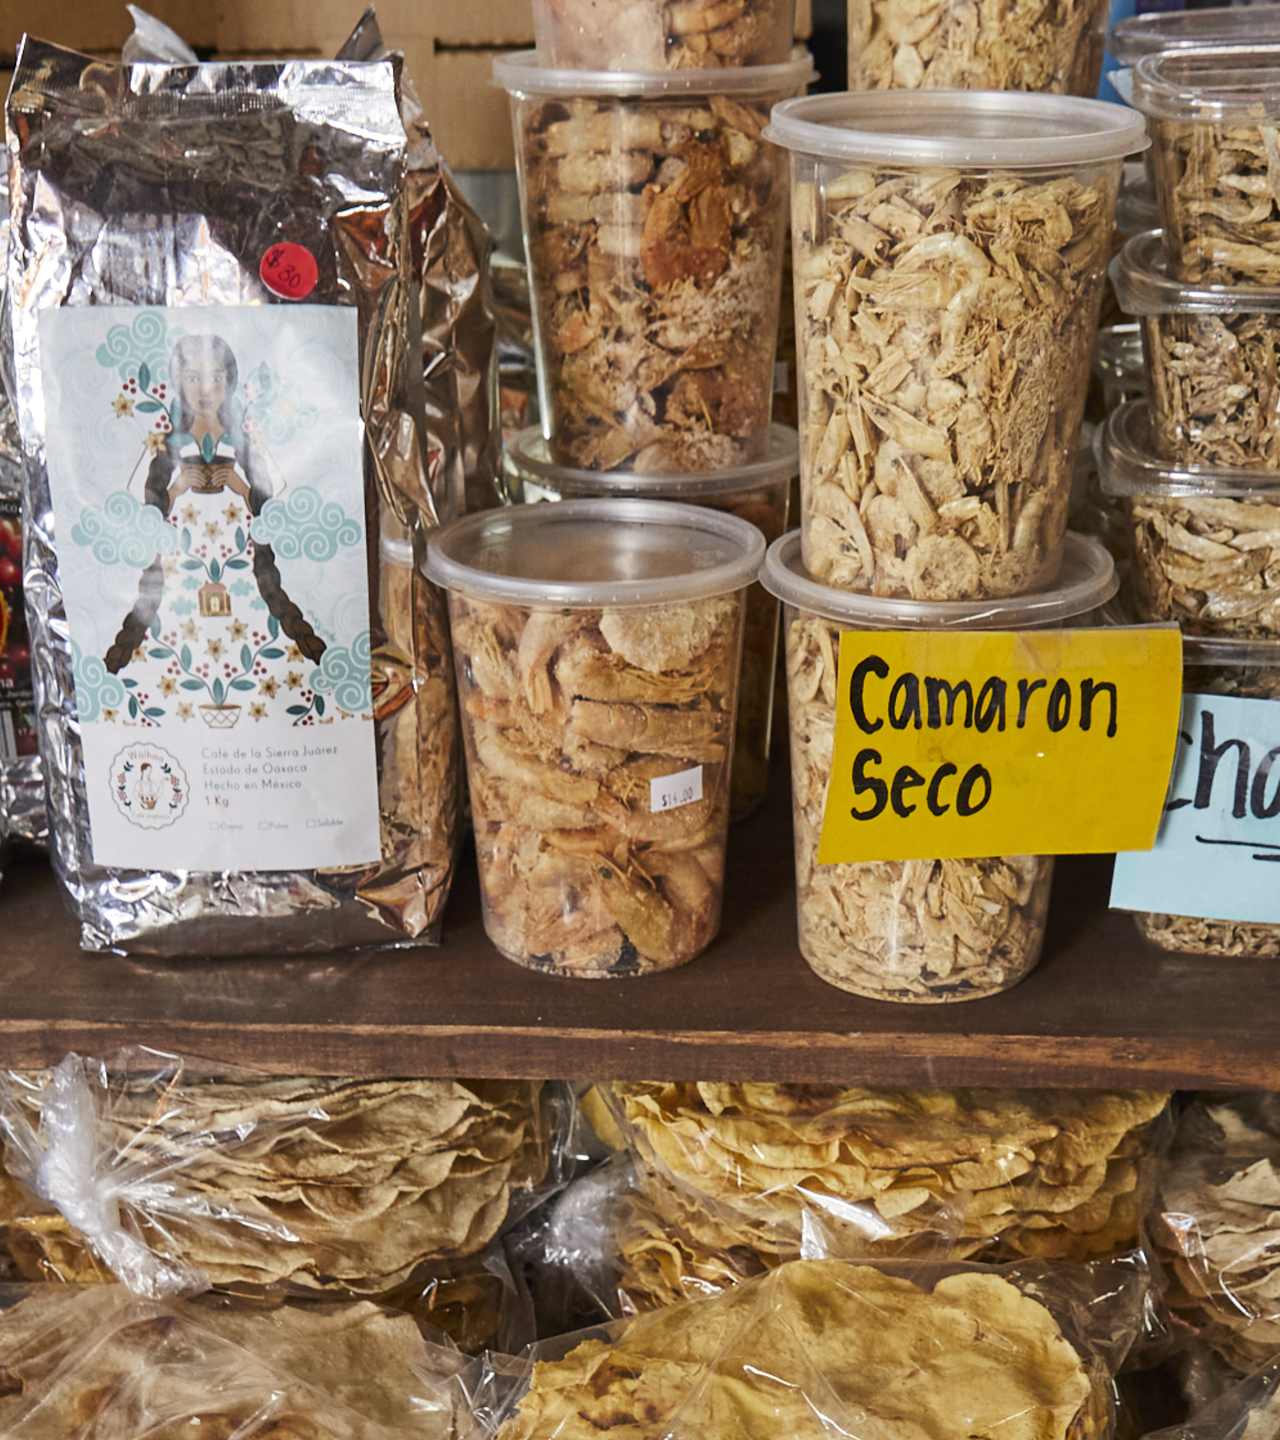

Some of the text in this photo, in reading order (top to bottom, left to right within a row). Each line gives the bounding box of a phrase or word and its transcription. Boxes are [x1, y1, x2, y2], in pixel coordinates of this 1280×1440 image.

[849, 655, 1118, 737] Camaron
[233, 747, 247, 758] de
[265, 747, 299, 758] Sierra
[203, 763, 307, 775] Estado de Oaxaca
[204, 780, 241, 791] Hecho
[244, 781, 258, 790] en
[851, 747, 991, 822] Seco
